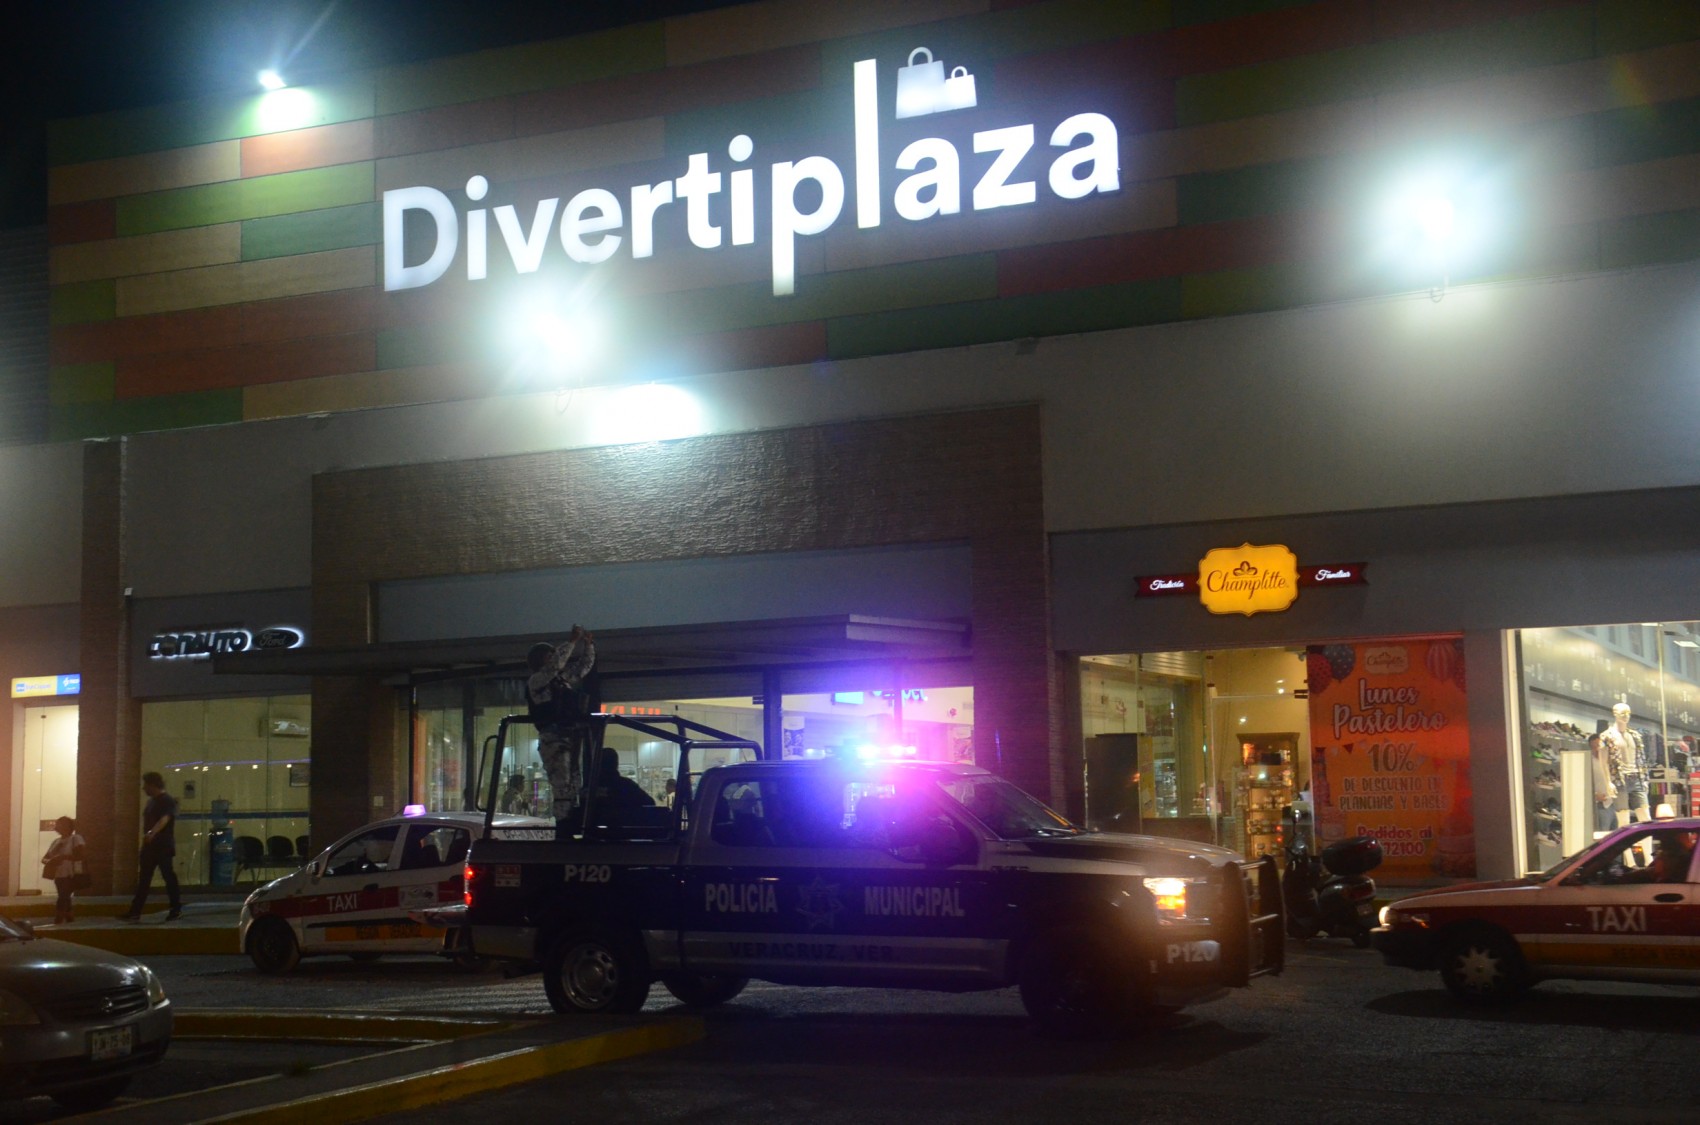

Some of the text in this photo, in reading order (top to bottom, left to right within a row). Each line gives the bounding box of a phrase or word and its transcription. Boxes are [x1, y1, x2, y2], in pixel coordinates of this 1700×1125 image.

[382, 58, 1121, 296] Divertiplaza
[1207, 569, 1288, 600] Champlitte
[1315, 569, 1352, 581] Familiar
[1359, 677, 1420, 711] Lunes
[1333, 701, 1448, 740] Pastelero
[1368, 743, 1418, 773] 10%
[1344, 777, 1359, 792] DE
[1362, 777, 1423, 792] DESCUENTO
[1340, 795, 1395, 810] PLANCHAS
[1400, 795, 1409, 810] Y
[1357, 826, 1433, 840] Pedidos al
[563, 864, 612, 884] P120
[326, 894, 358, 912] TAXI
[863, 886, 965, 917] MUNICIPAL
[1586, 906, 1648, 932] TAXI
